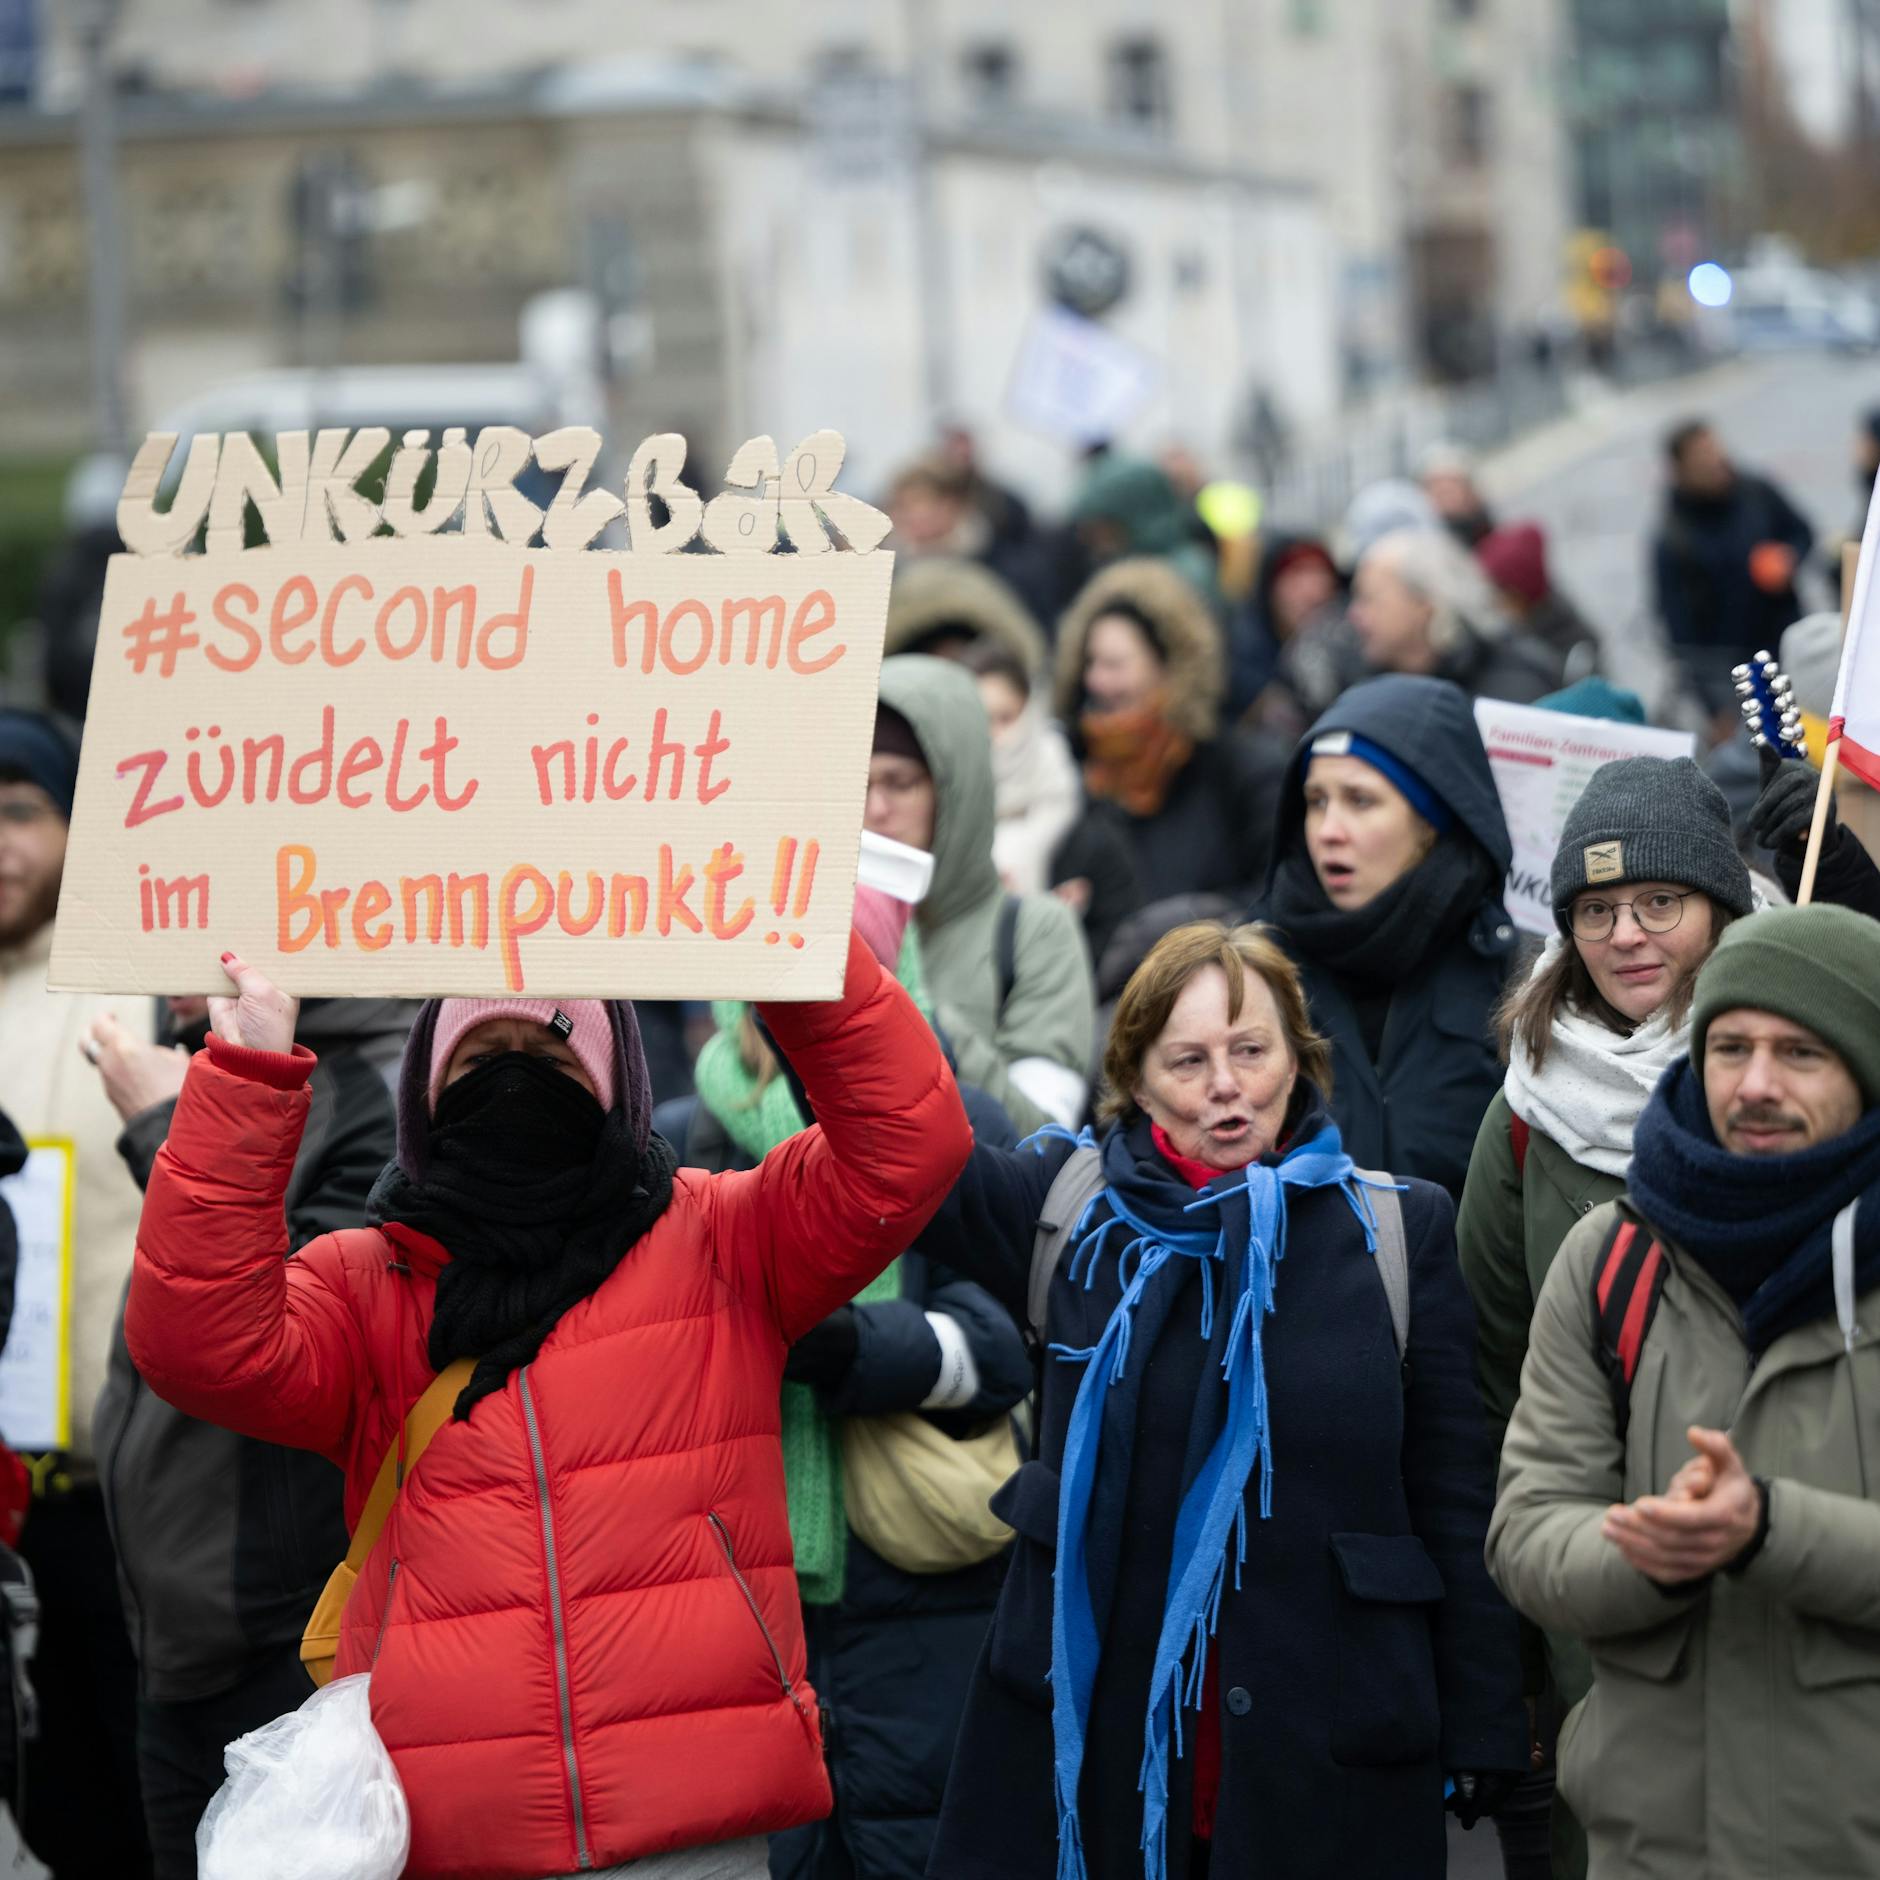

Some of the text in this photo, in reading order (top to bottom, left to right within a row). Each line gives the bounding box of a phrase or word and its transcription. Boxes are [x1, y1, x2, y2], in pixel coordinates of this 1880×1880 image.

[122, 565, 847, 678] #second home
[116, 705, 732, 829] zündelt nicht
[139, 836, 821, 992] im Brennpunkt!!
